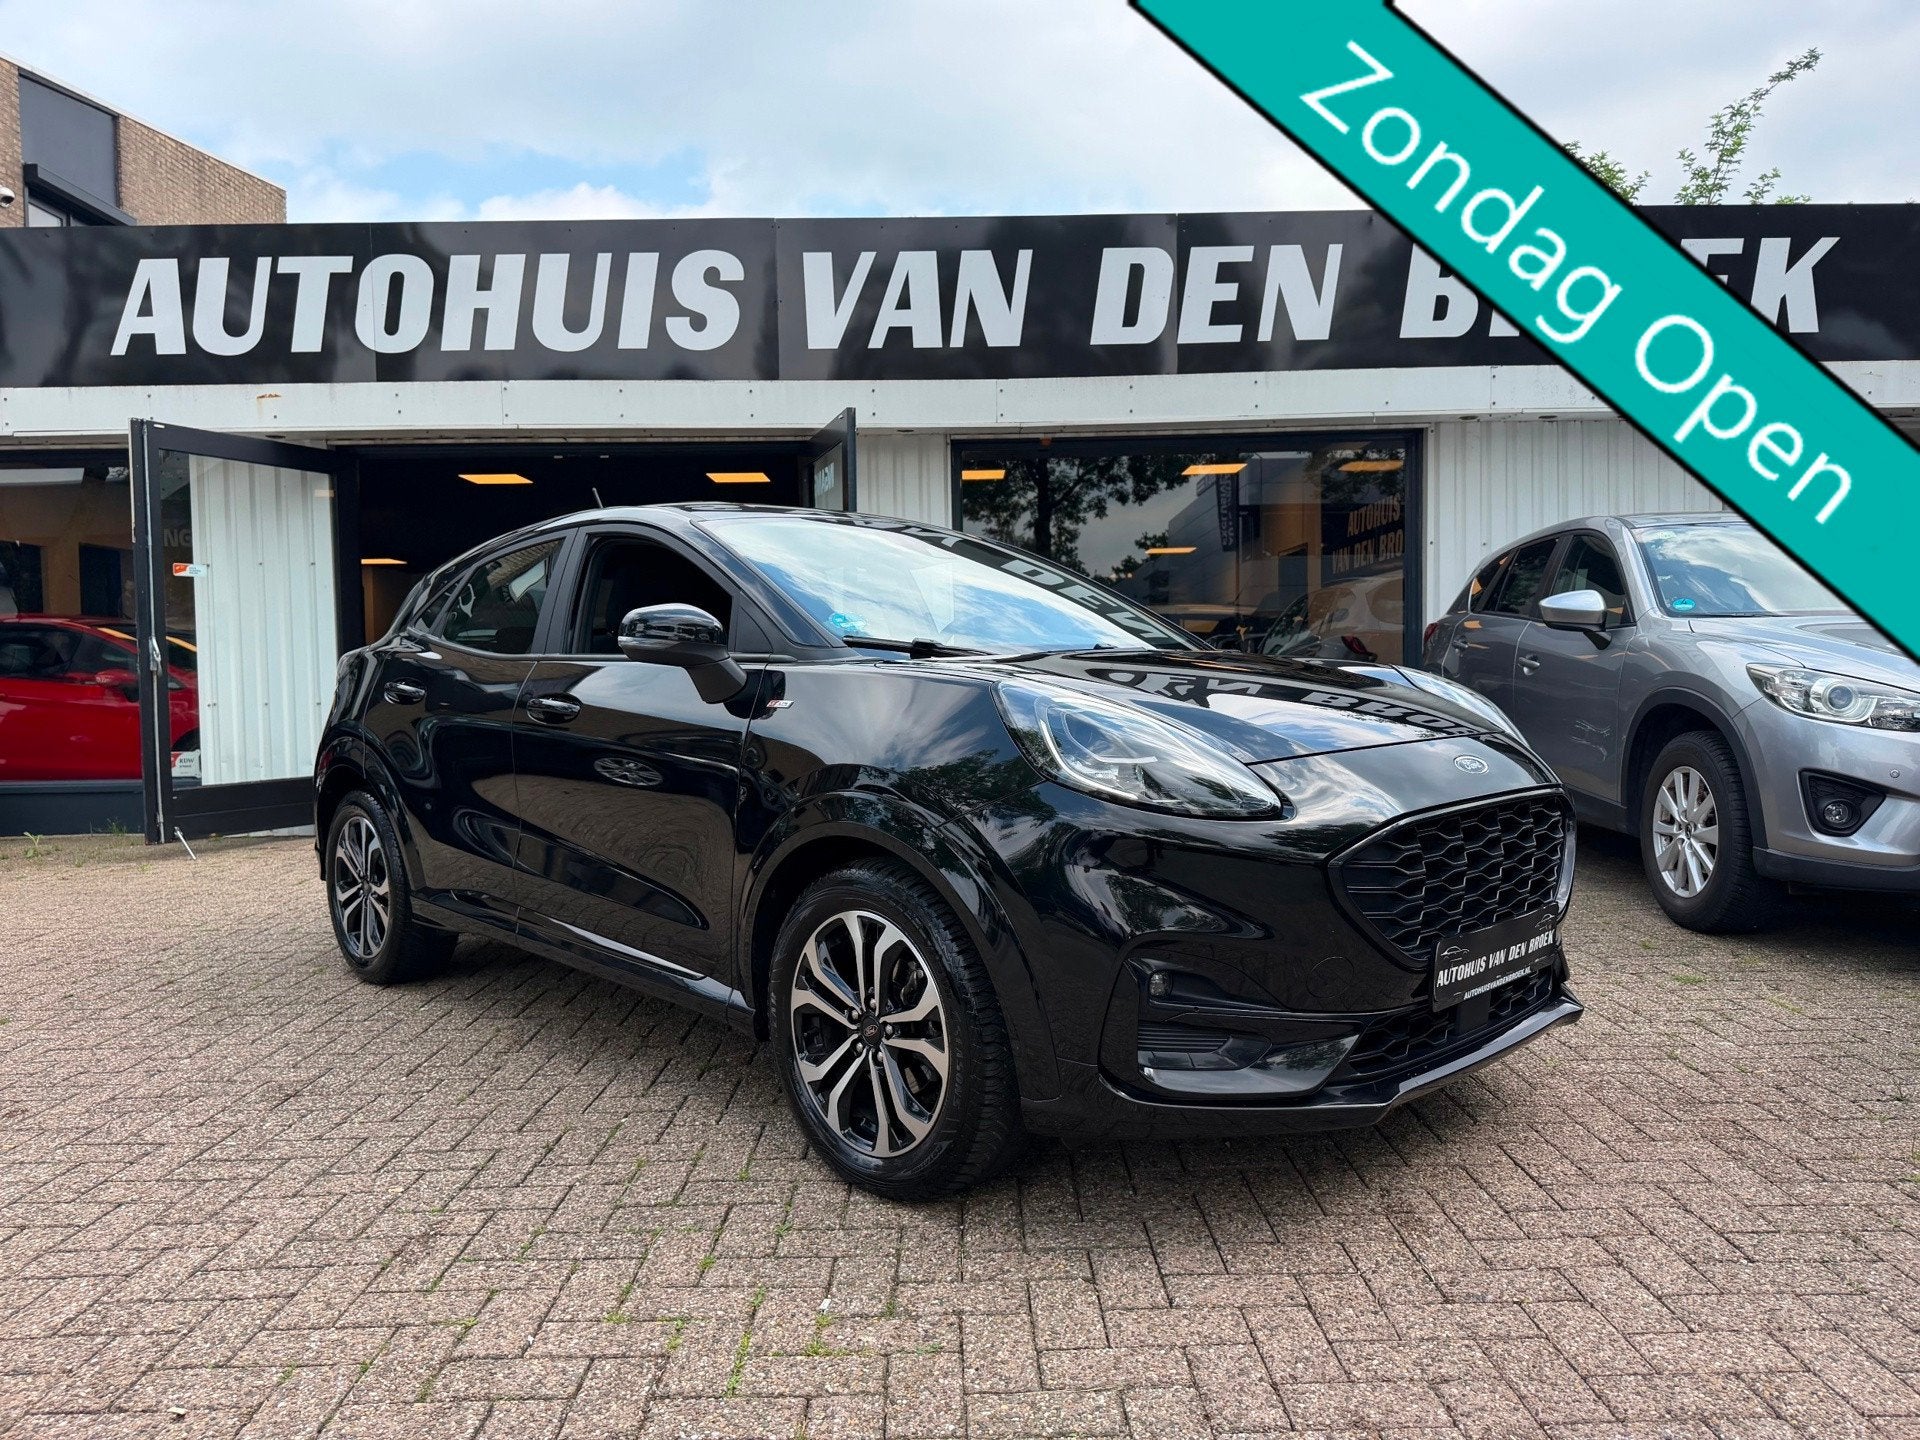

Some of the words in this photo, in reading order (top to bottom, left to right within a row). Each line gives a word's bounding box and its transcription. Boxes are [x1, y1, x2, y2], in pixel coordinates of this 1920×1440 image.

[111, 250, 745, 355] AUTOHUIS
[803, 250, 1033, 350] VAN
[1090, 244, 1344, 345] DEN
[1347, 493, 1400, 537] AUTOHUIS
[1332, 545, 1351, 575] VAN
[1354, 538, 1375, 568] DEN
[1437, 956, 1486, 987] AUTOHUIS
[1488, 949, 1507, 969] VAN
[1508, 941, 1528, 961] DEN
[1528, 929, 1555, 953] BROEK
